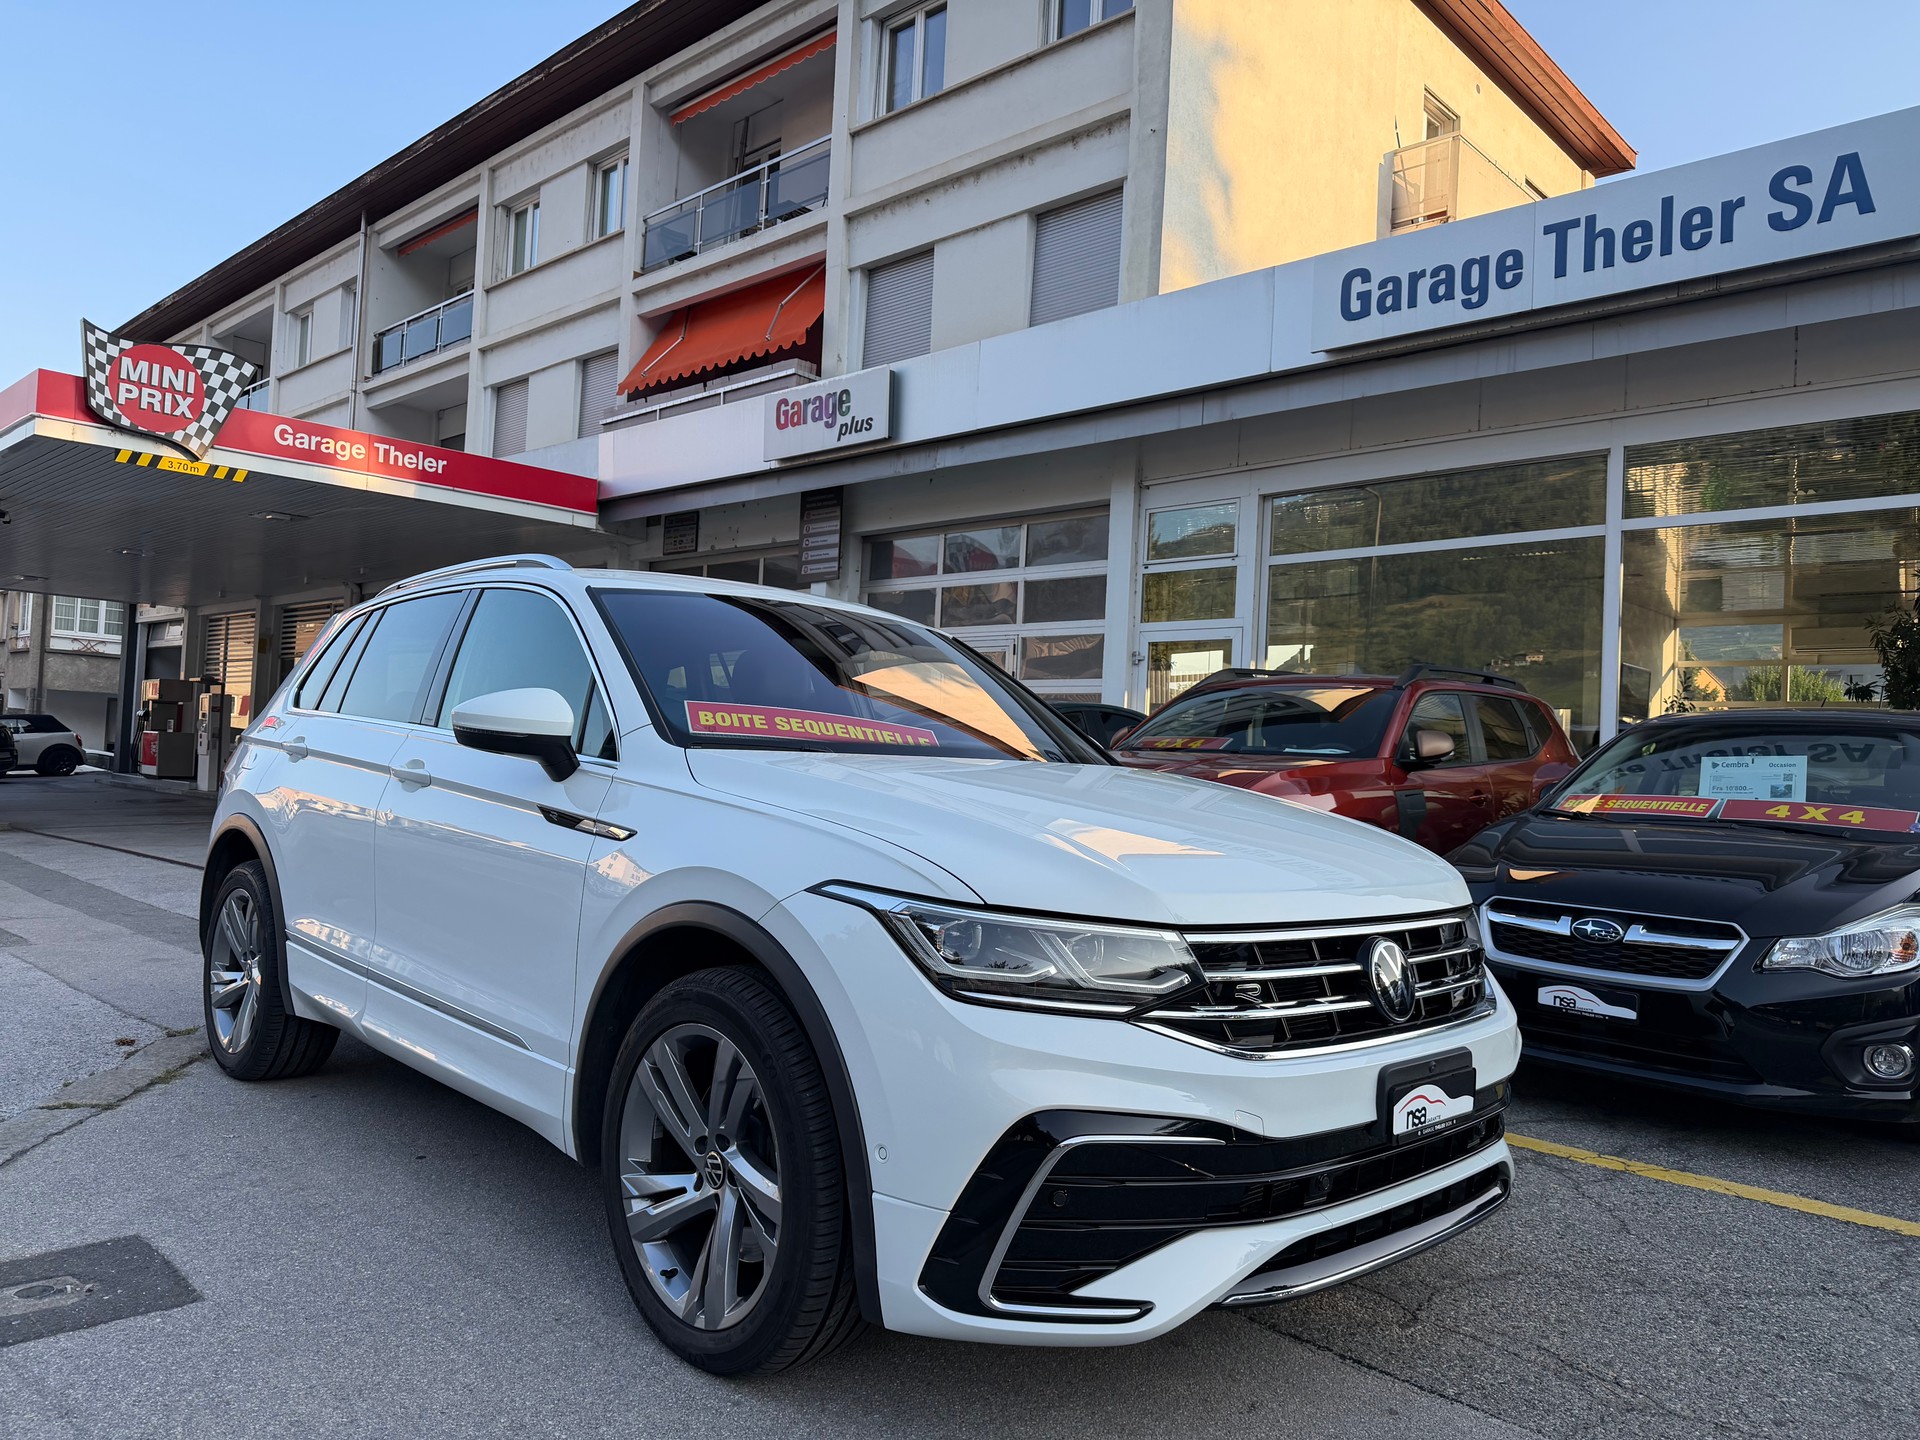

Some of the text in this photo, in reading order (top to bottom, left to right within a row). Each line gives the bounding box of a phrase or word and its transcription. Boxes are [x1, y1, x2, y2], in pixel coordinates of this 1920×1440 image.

[1339, 151, 1876, 322] Garage Theler SA
[119, 356, 196, 394] MINI
[117, 382, 195, 420] PRIX
[776, 388, 852, 431] Garage
[836, 416, 874, 442] plus
[273, 424, 448, 474] Garage Theler
[698, 711, 769, 729] BOITE
[1605, 800, 1709, 813] SEQUENTIELLE
[1553, 995, 1577, 1008] nsa
[1406, 1106, 1427, 1129] nsa
